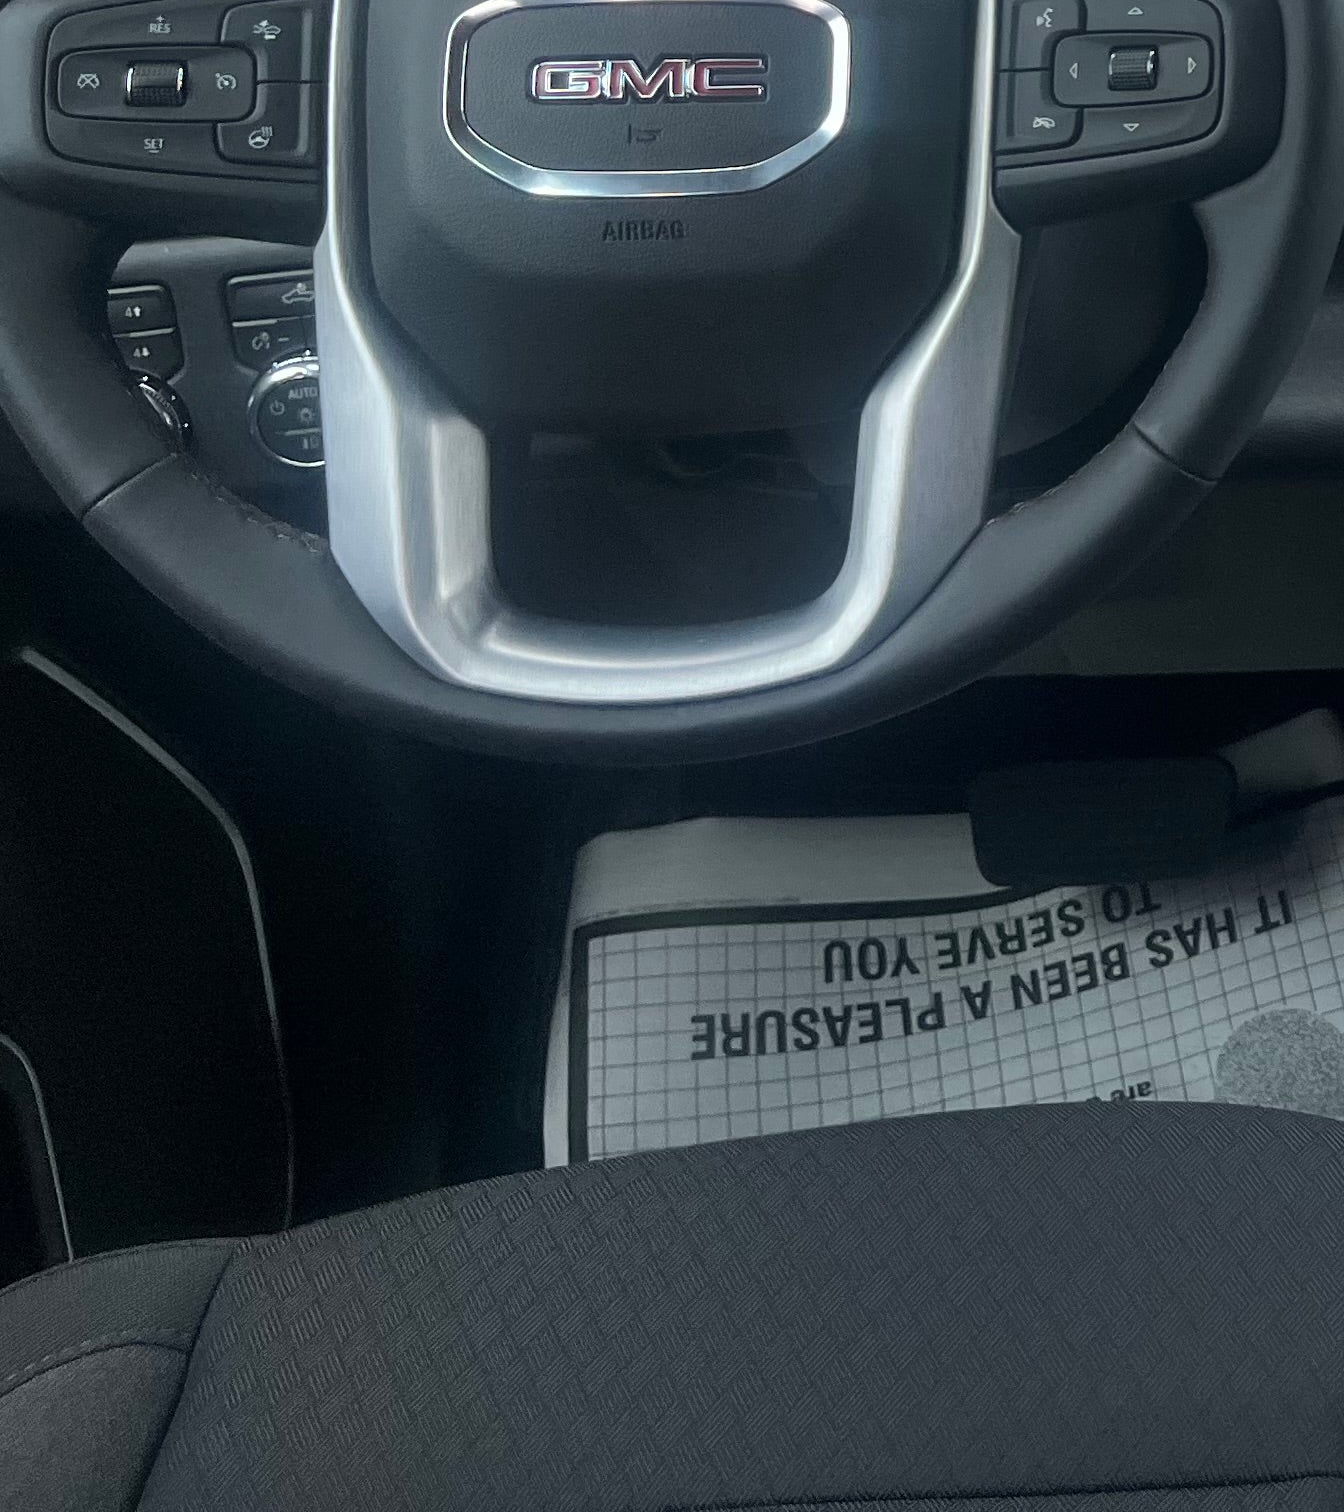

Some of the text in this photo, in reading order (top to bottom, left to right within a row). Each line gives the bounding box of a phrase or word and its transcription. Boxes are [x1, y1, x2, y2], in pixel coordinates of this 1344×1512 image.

[149, 24, 171, 34] RES
[531, 58, 765, 99] GMC
[144, 139, 164, 149] SET
[603, 220, 686, 241] AIRBAG
[288, 388, 318, 399] AUTO
[822, 885, 1162, 985] TO SERVE YOU
[690, 890, 1293, 1061] IT HAS BEEN A PLEASURE
[1110, 1081, 1151, 1102] are
